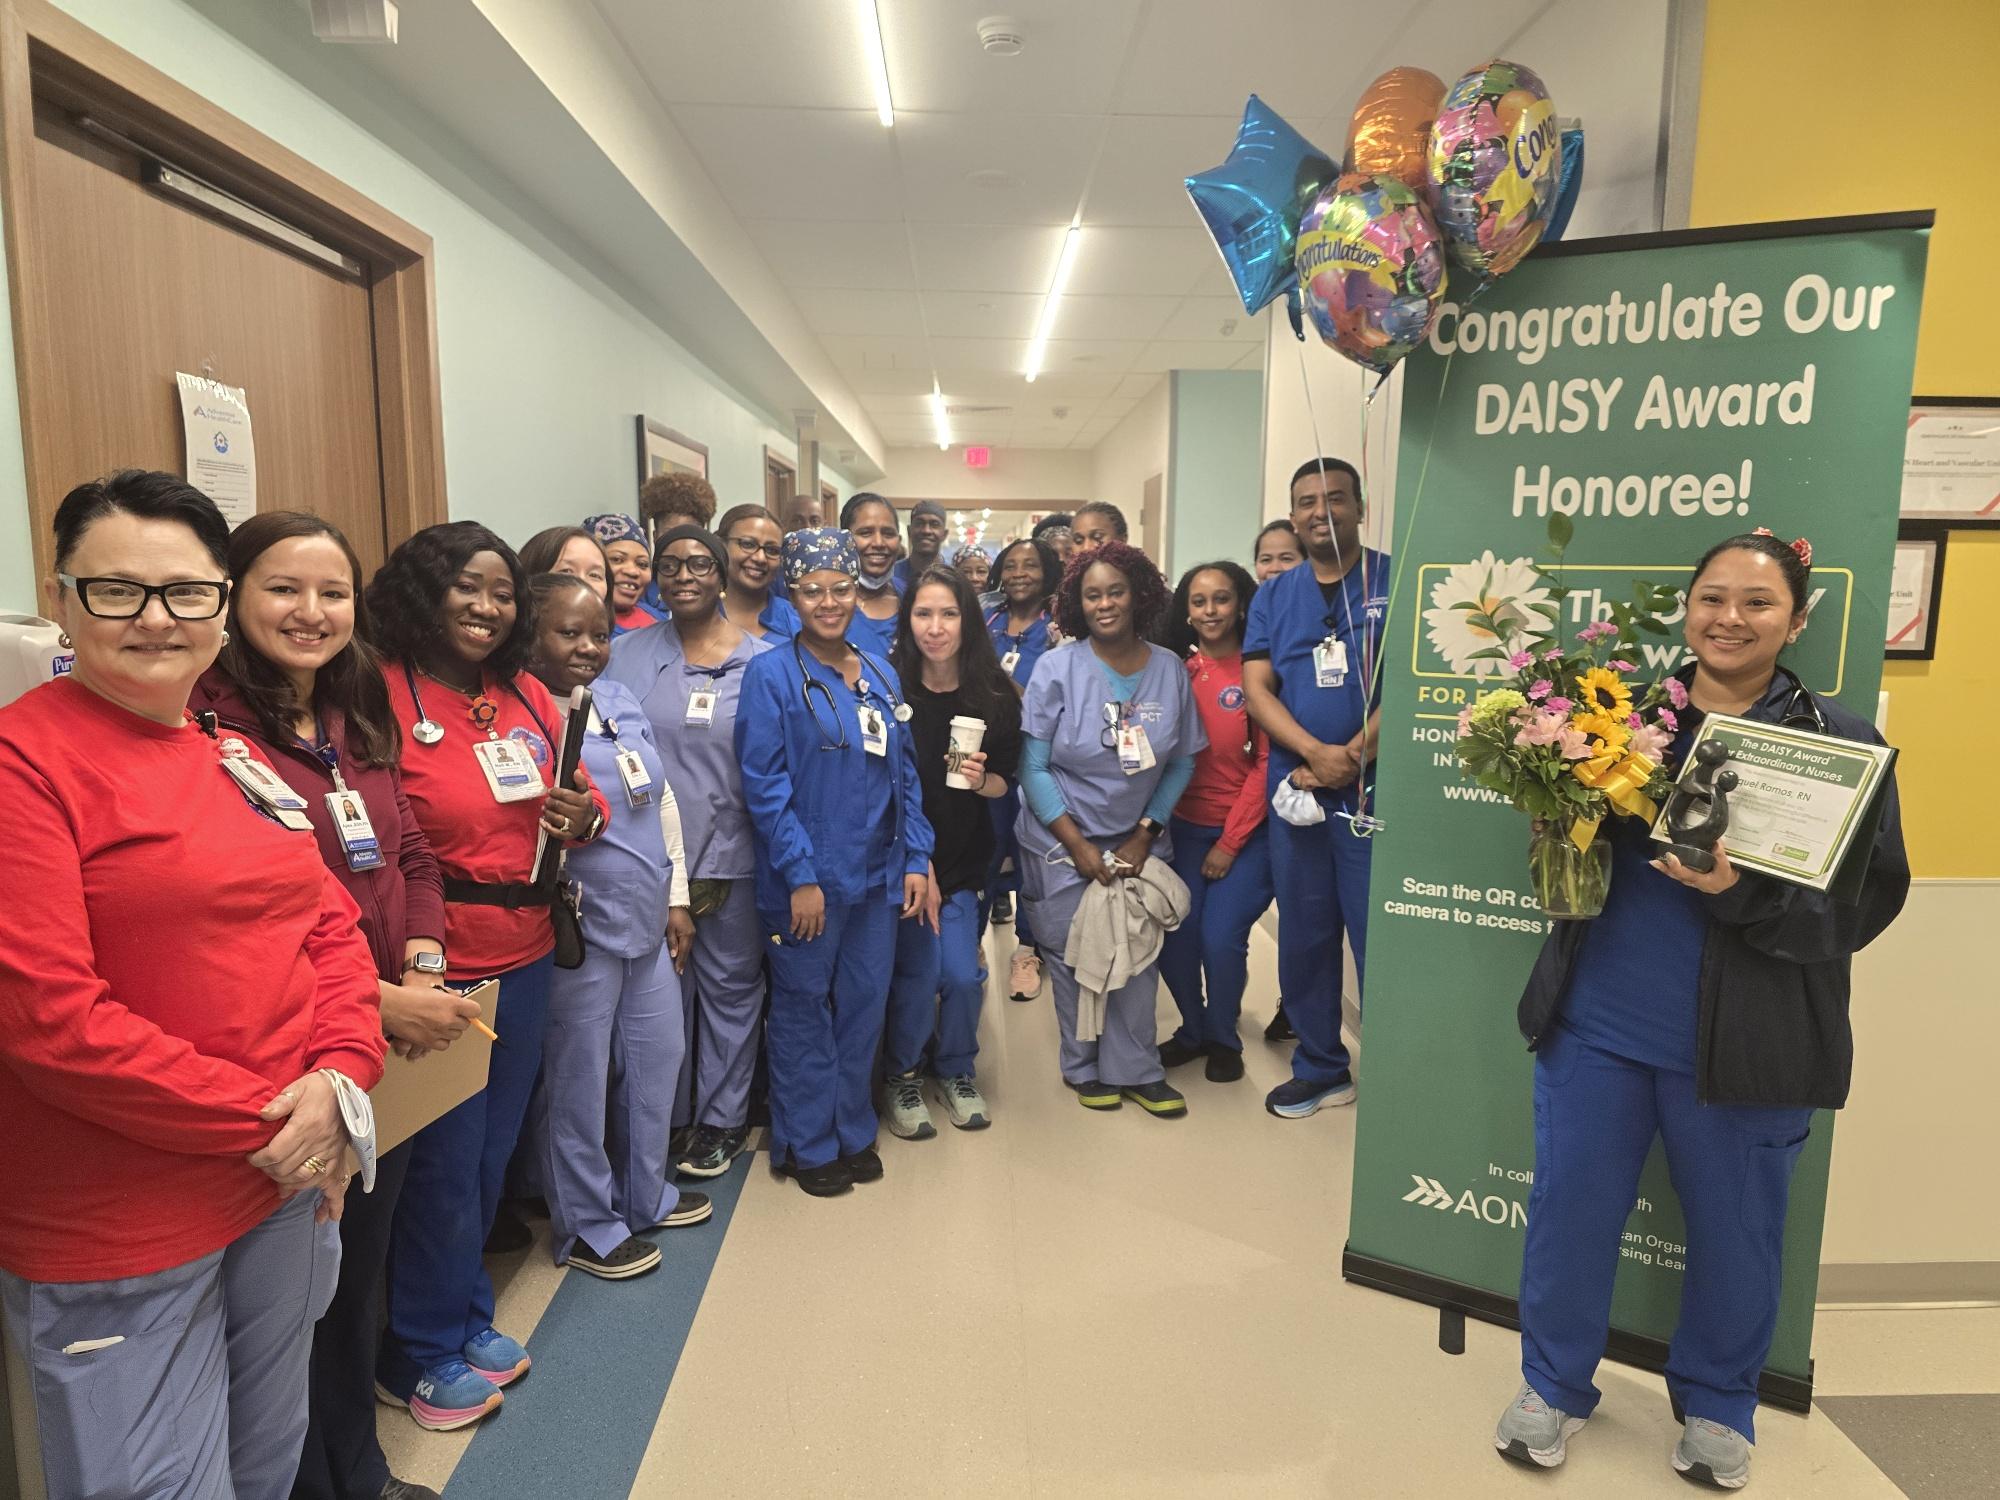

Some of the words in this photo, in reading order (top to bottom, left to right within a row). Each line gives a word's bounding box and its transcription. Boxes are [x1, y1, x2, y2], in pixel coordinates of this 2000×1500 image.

[1298, 234, 1382, 281] gratulations
[1429, 282, 1763, 365] Congratulate
[1784, 274, 1895, 333] Our
[1475, 377, 1624, 435] DAISY
[1634, 363, 1816, 430] Award
[1512, 459, 1753, 517] Honoree!
[1418, 686, 1467, 705] FOR
[1140, 712, 1163, 722] PCT
[1433, 752, 1453, 767] IN
[1741, 738, 1759, 750] The
[1760, 742, 1794, 757] DAISY
[1735, 752, 1805, 774] Extraordinary
[1805, 767, 1843, 782] Nurses
[1737, 777, 1759, 789] quel
[1797, 792, 1812, 802] RN
[1402, 877, 1448, 898] Scan
[1452, 884, 1482, 902] the
[1486, 888, 1517, 907] QR
[1384, 900, 1450, 921] camera
[1453, 907, 1473, 924] to
[1475, 915, 1543, 934] access
[1488, 1162, 1503, 1177] In
[1619, 1246, 1652, 1265] sing
